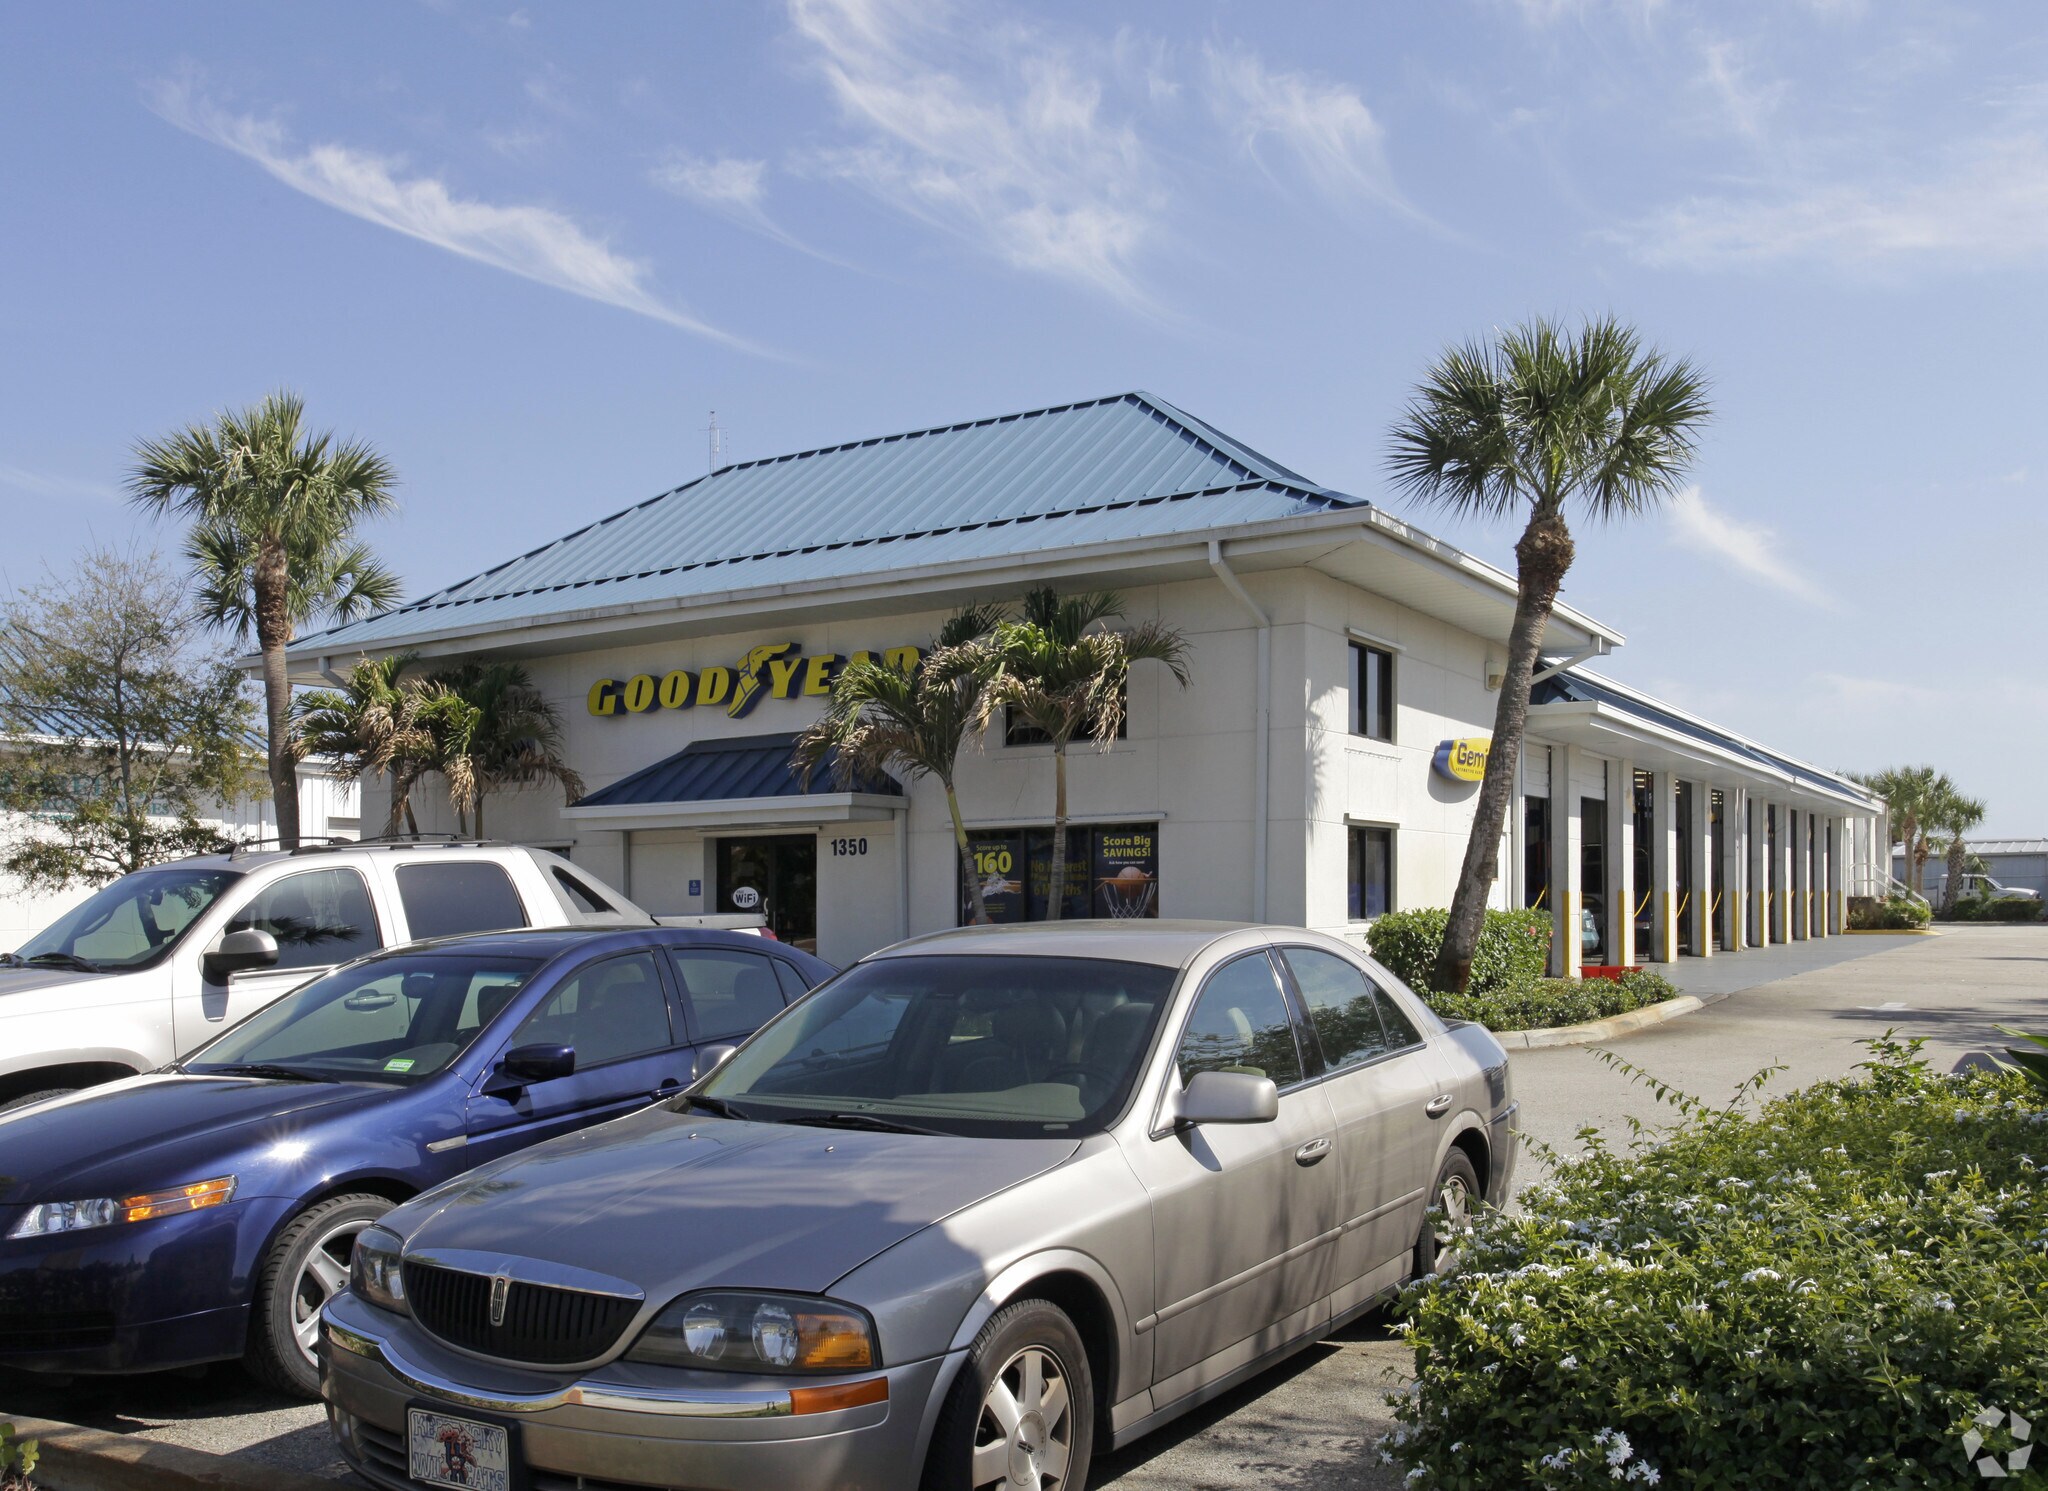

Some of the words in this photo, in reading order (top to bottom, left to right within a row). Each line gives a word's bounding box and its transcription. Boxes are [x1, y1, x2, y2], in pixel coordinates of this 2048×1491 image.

[831, 838, 867, 856] 1350
[1103, 836, 1132, 846] Score
[1134, 835, 1151, 847] Big
[992, 844, 1000, 852] up
[1103, 847, 1151, 858] SAVINGS!
[1031, 860, 1044, 873] No
[1047, 859, 1088, 873] Ierest
[1042, 883, 1082, 896] Mths
[735, 893, 756, 904] WiFi
[413, 1414, 504, 1454] KECKY
[413, 1451, 506, 1491] WILATS
